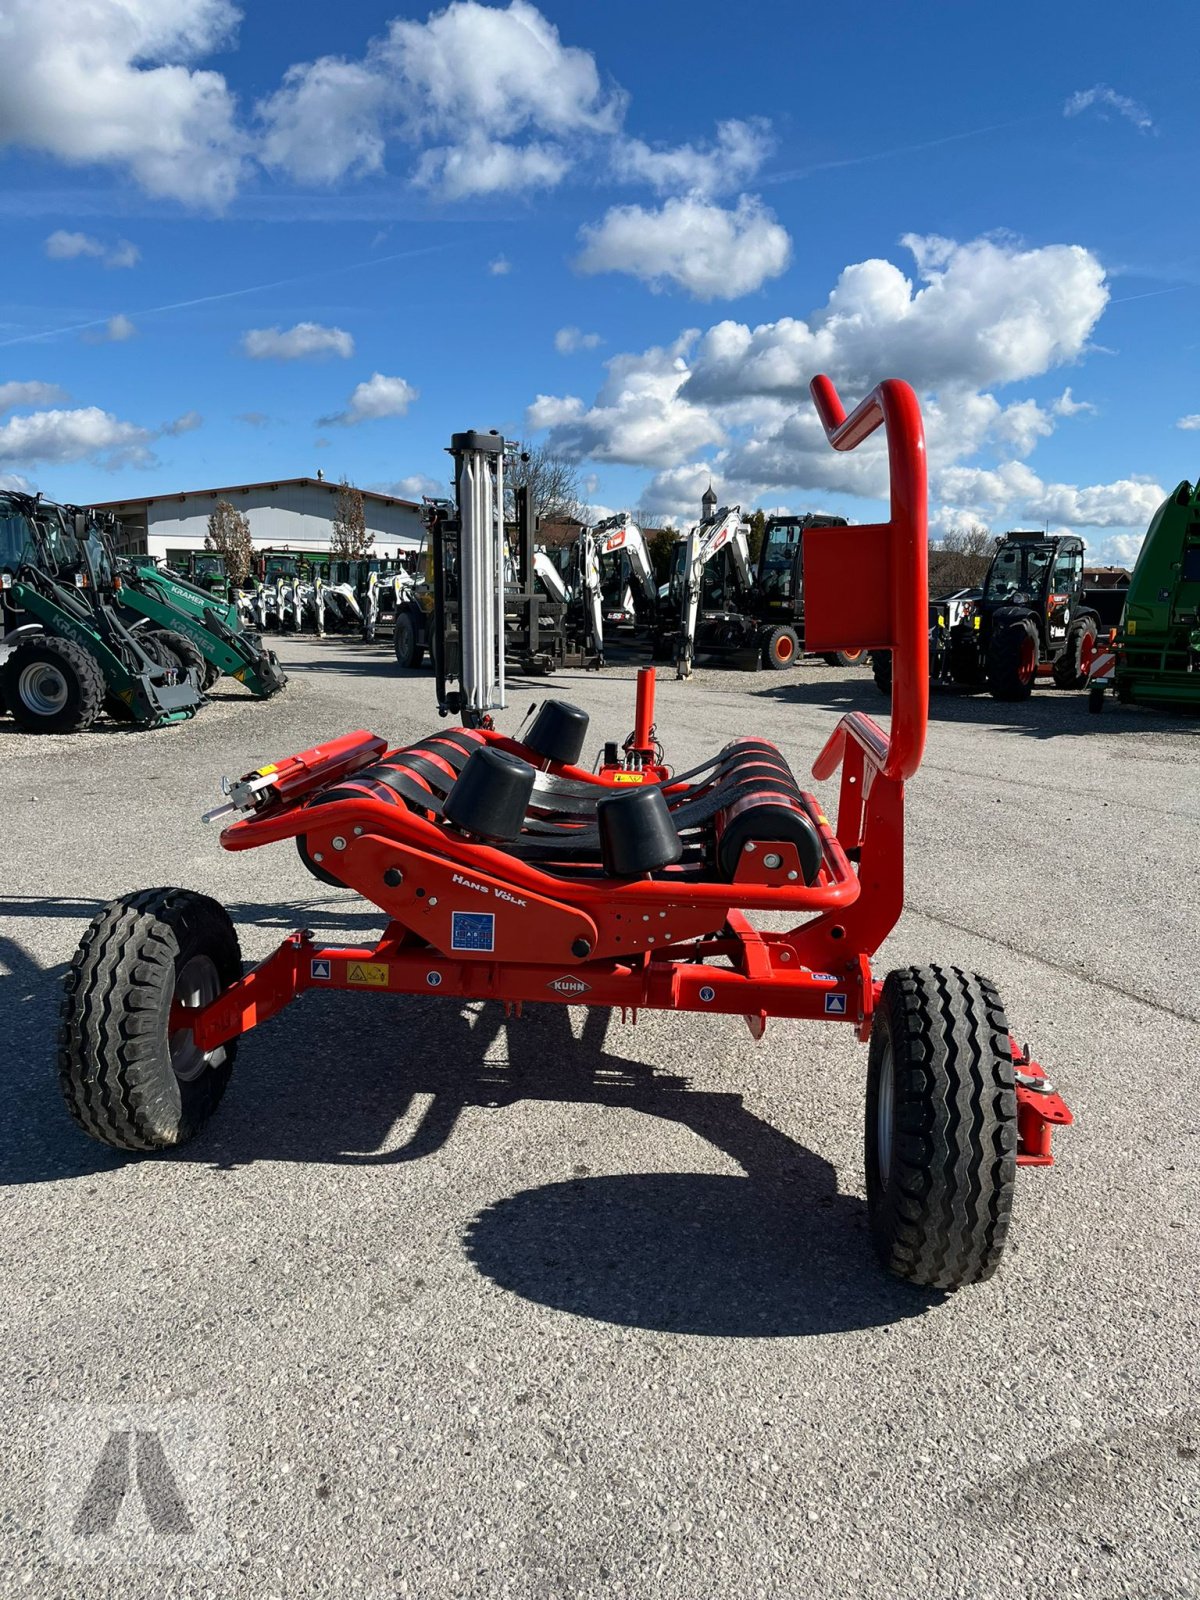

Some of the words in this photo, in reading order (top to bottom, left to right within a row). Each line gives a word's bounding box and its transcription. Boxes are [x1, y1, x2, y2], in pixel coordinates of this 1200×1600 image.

[171, 585, 205, 606] KRAMER
[170, 618, 216, 654] KRAMER
[452, 873, 489, 893] HANS
[494, 888, 528, 907] VÖLK
[554, 981, 586, 991] KUHN
